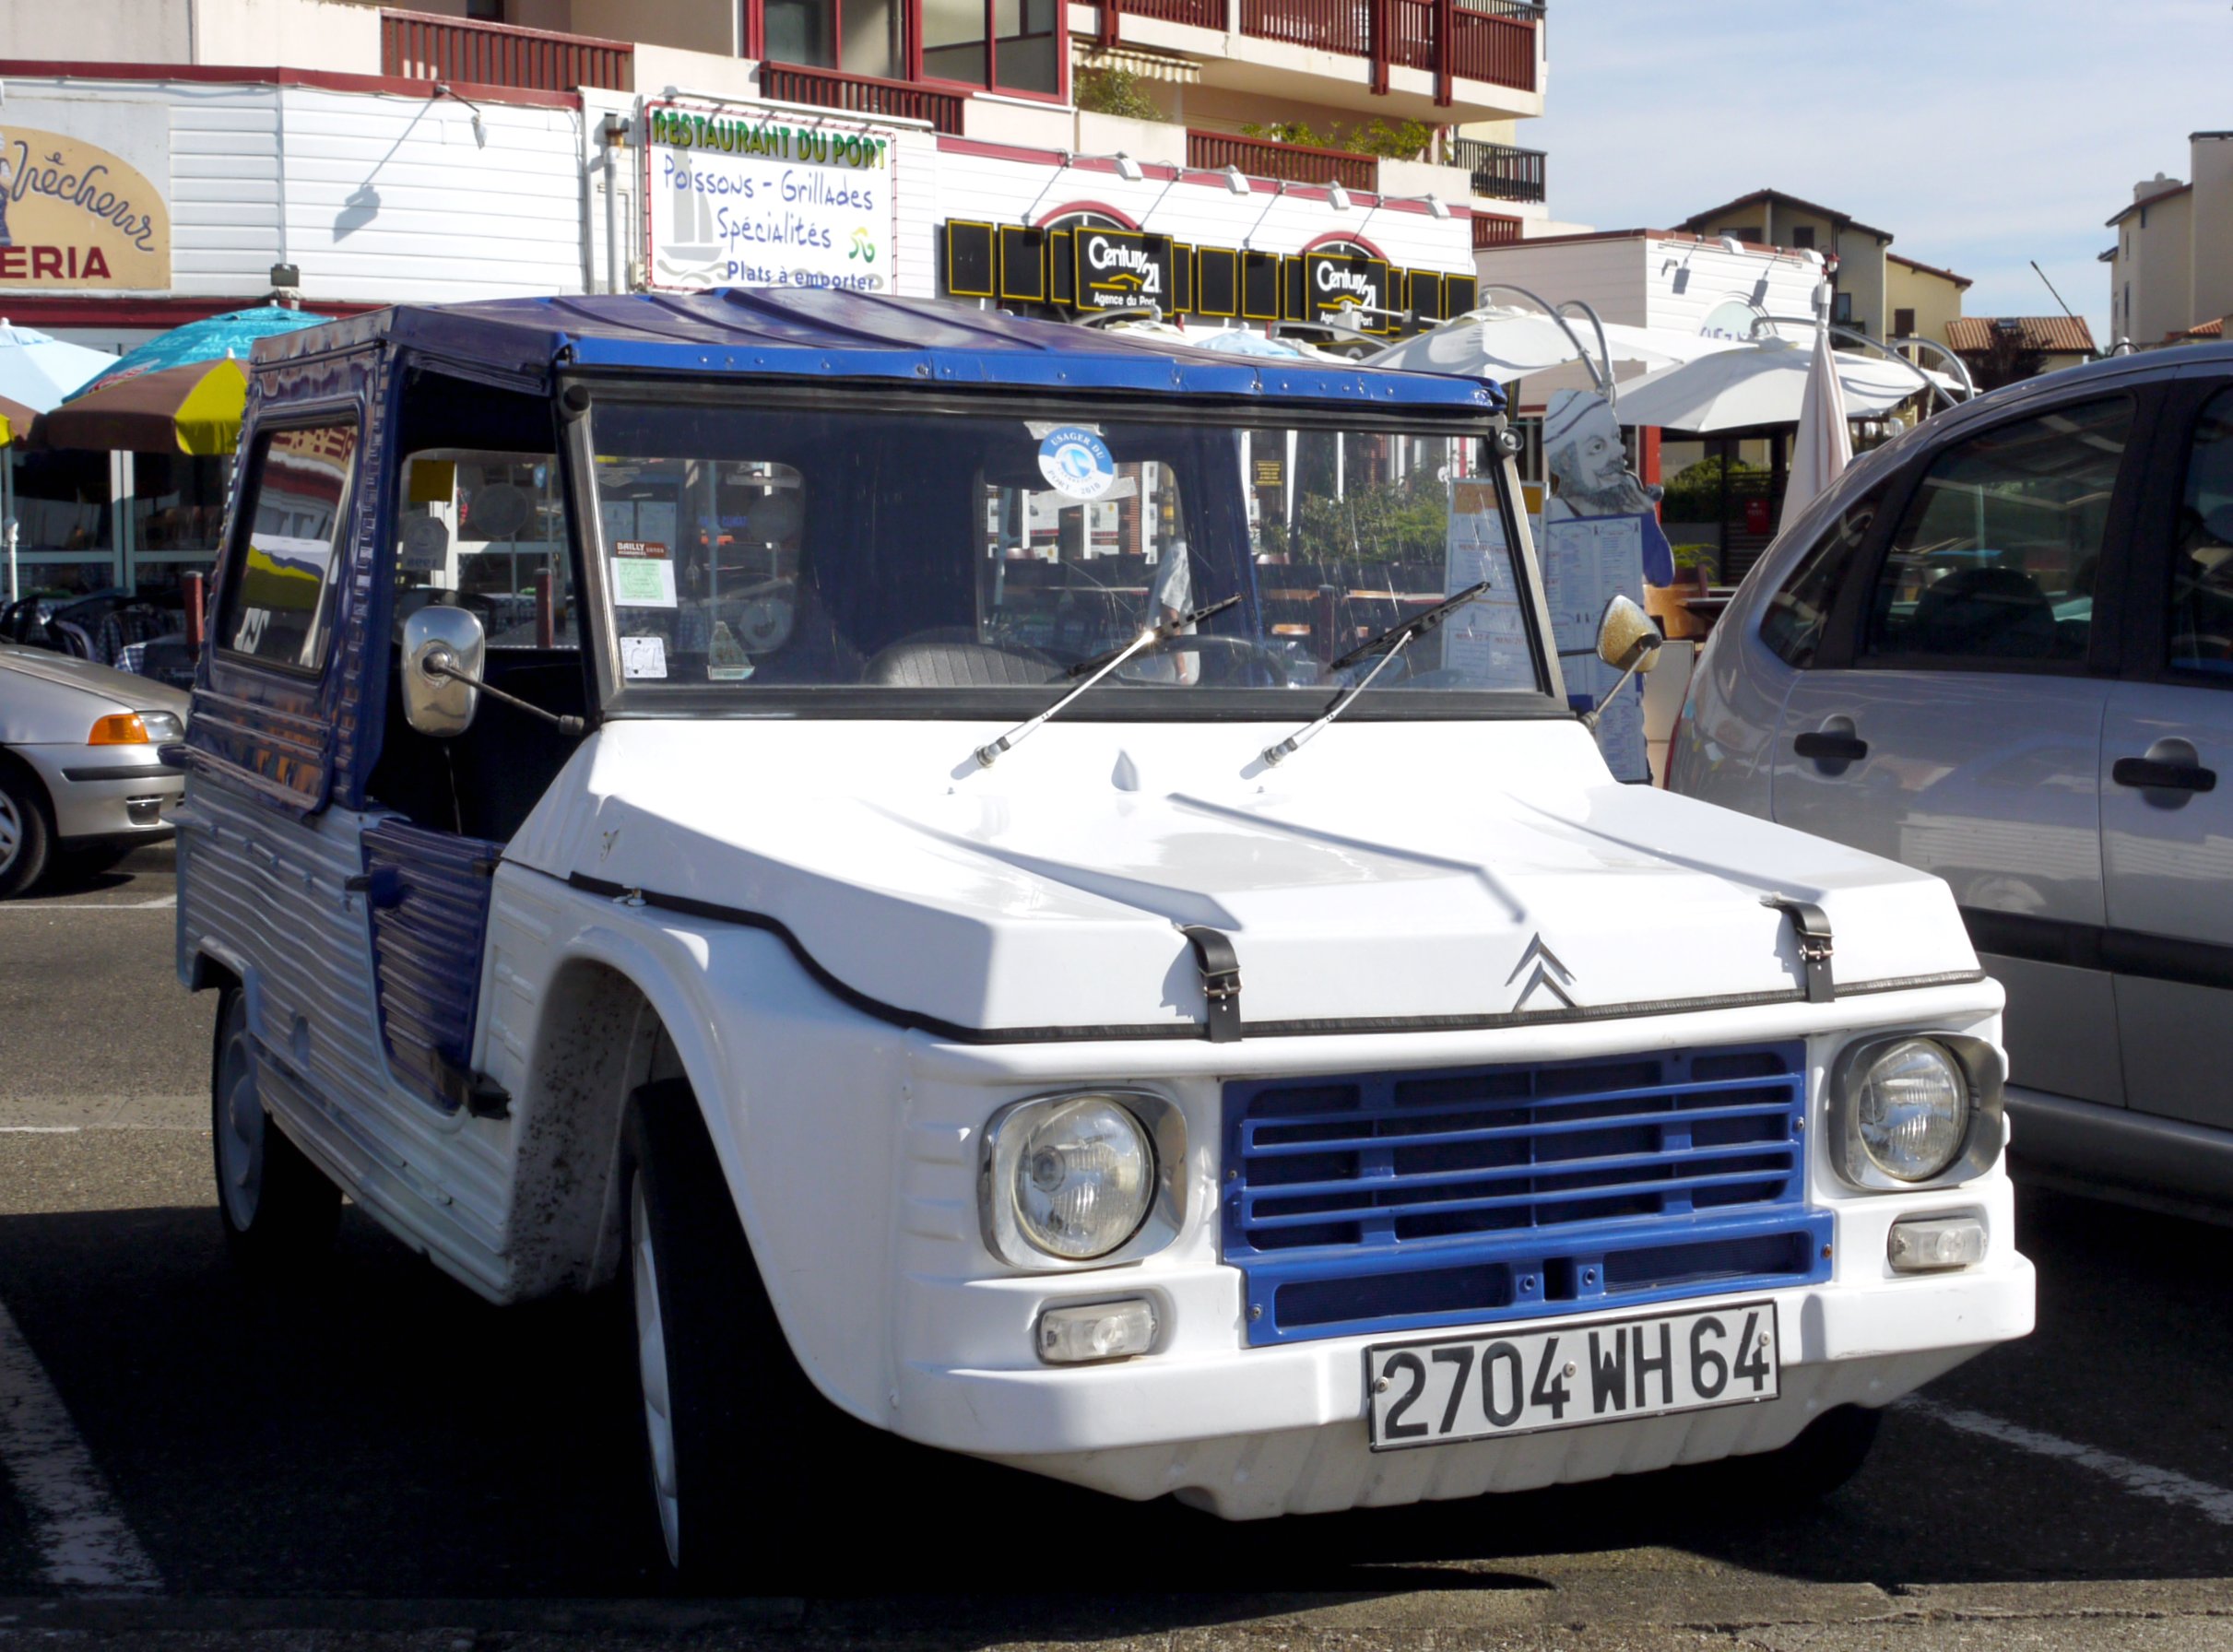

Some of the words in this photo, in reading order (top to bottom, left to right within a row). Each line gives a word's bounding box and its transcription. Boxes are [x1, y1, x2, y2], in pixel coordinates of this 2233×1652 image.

[651, 109, 791, 159] RESTAURANT
[797, 127, 827, 163] DU
[832, 132, 887, 170] PORT
[664, 154, 754, 199] Poissons
[781, 170, 874, 211] Grillades
[716, 206, 832, 254] Spécialités
[727, 261, 772, 283] Plats
[778, 266, 787, 284] à
[794, 272, 875, 291] emporter
[1088, 235, 1149, 274] Century
[1141, 262, 1160, 293] 21
[1316, 260, 1367, 295] Century
[1093, 290, 1124, 308] Agence
[1126, 294, 1137, 306] du
[1139, 295, 1156, 306] Port
[1050, 431, 1091, 446] USAGER
[1091, 443, 1105, 460] DU
[1383, 1335, 1571, 1440] 2704
[1588, 1322, 1673, 1414] WH
[1688, 1311, 1769, 1399] 64
